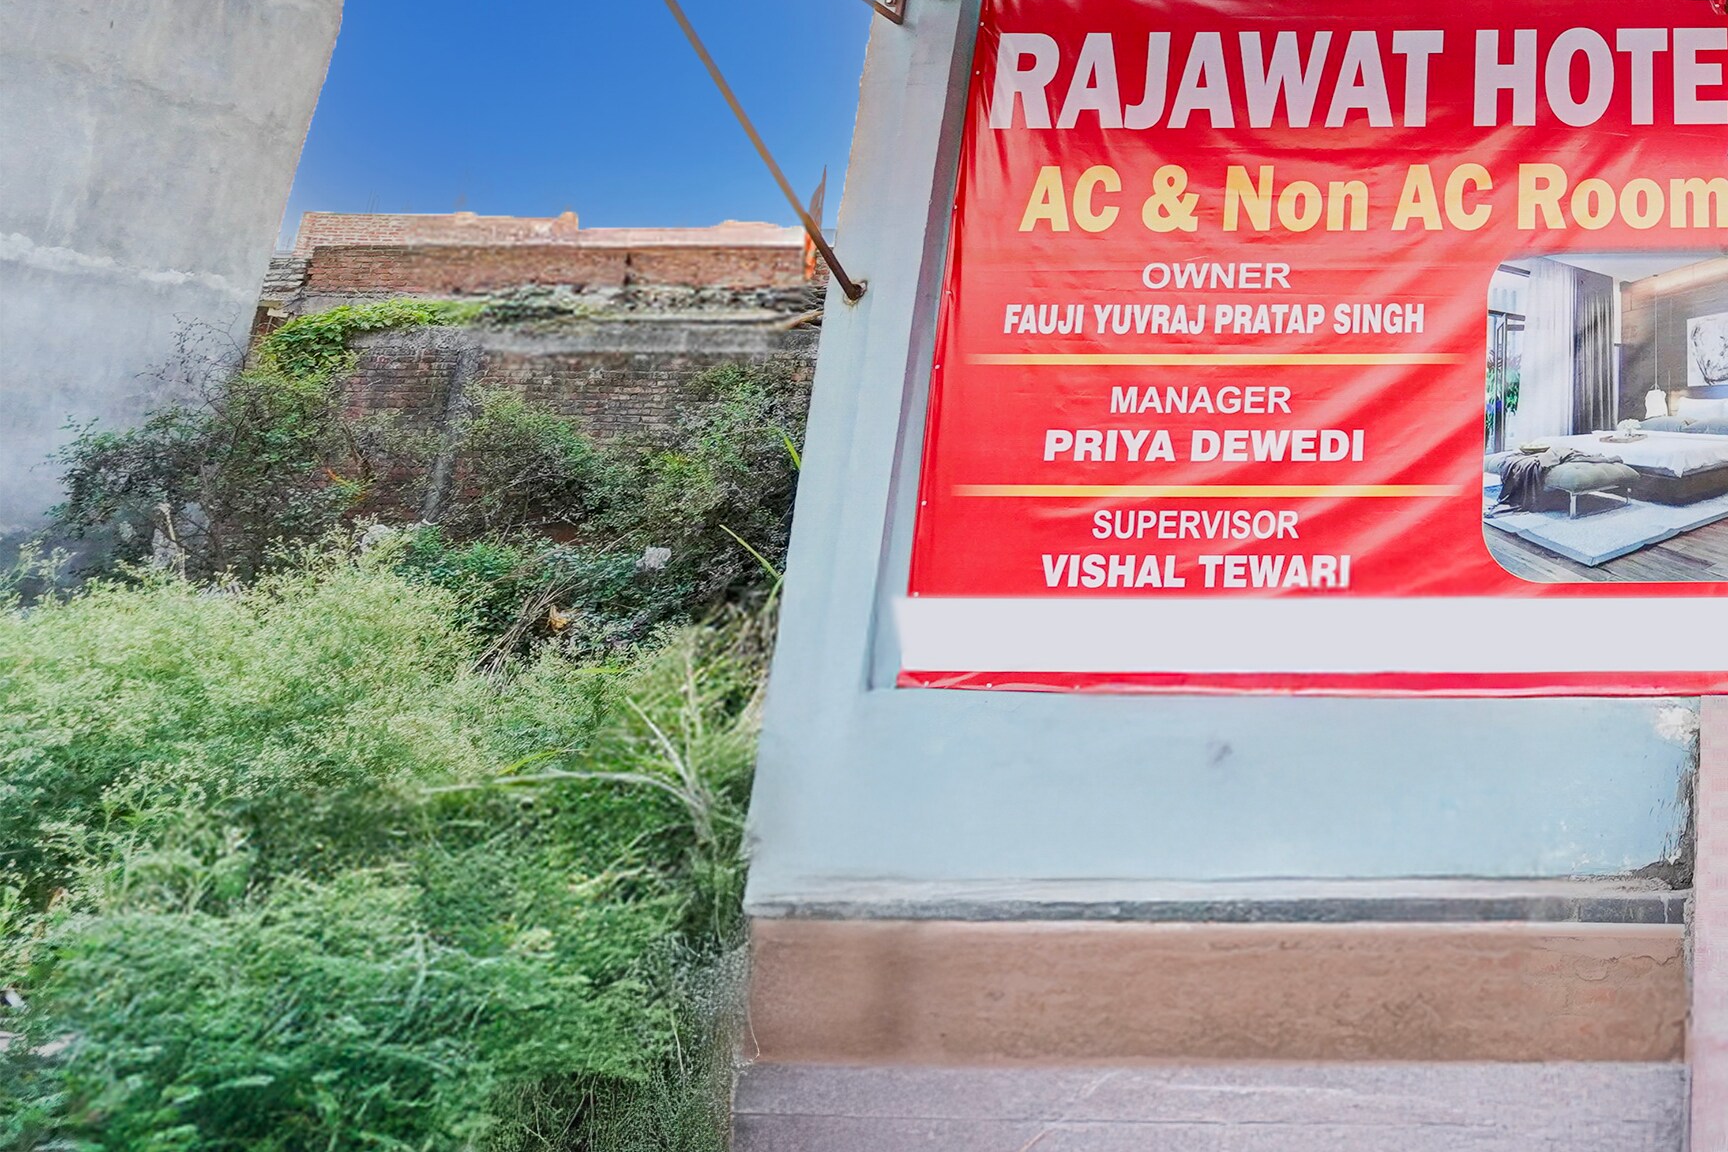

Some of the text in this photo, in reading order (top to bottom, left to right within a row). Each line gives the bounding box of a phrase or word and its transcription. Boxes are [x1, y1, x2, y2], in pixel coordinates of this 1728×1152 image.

[989, 30, 1444, 130] RAJAWAT
[1019, 165, 1120, 233] AC
[1142, 164, 1198, 232] &
[1223, 165, 1368, 232] Non
[1391, 163, 1492, 231] AC
[1141, 262, 1291, 289] OWNER
[1003, 304, 1425, 335] FAUJI YUVRAJ PRATAP SINGH
[1109, 386, 1291, 415] MANAGER
[1043, 429, 1365, 462] PRIYA DEWEDI
[1092, 510, 1299, 540] SUPERVISOR
[1041, 555, 1349, 588] VISHAL TEWARI
